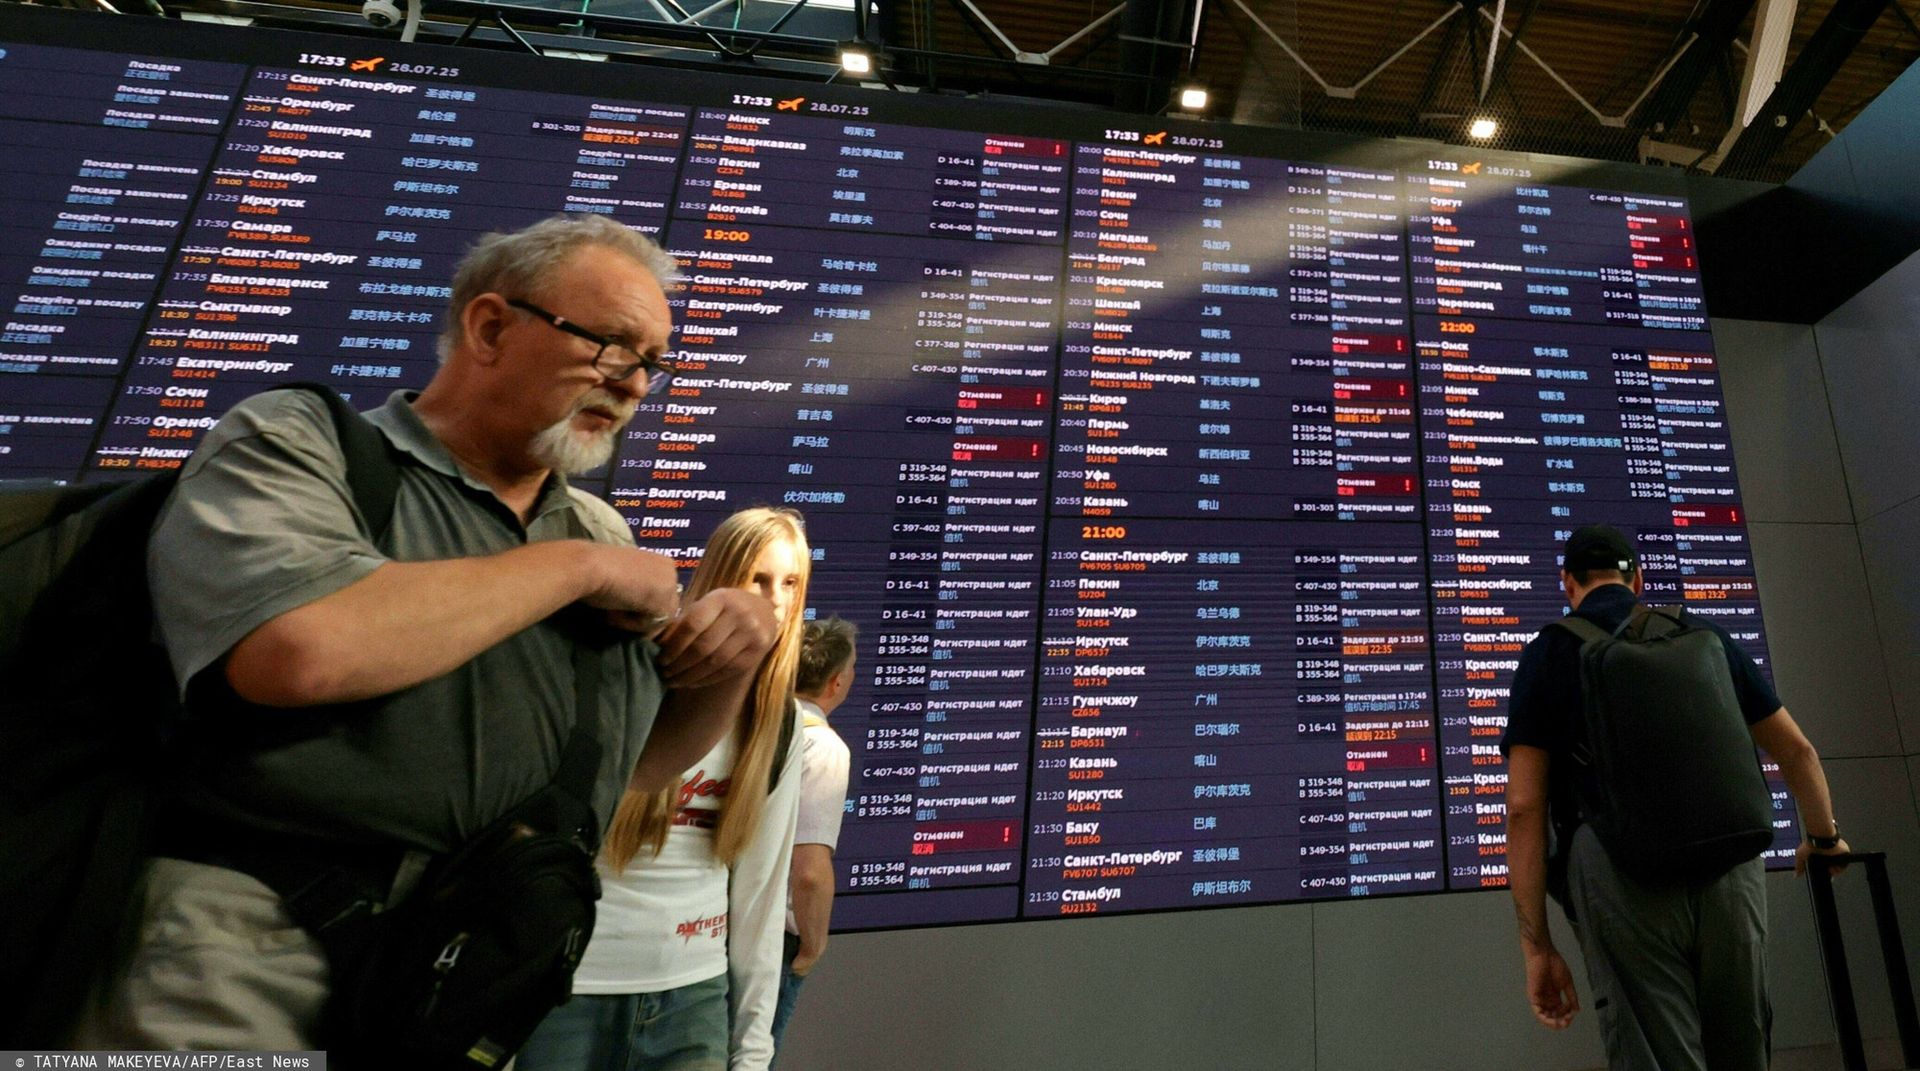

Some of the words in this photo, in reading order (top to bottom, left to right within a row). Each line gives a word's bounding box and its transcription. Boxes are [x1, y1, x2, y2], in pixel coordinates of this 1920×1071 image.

[128, 60, 181, 72] Посадка
[298, 54, 346, 66] 17:33
[390, 62, 460, 77] 28.07.25
[256, 71, 288, 81] 17:15
[290, 74, 416, 94] Санкт-Петербург
[118, 85, 166, 96] Посадка
[169, 89, 230, 100] закончена
[280, 97, 355, 112] Оренбург
[732, 95, 772, 106] 17:33
[810, 102, 869, 115] 28.07.25
[700, 112, 726, 120] 18:40
[728, 114, 770, 126] Минск
[237, 118, 269, 128] 17:20
[271, 120, 372, 138] Калининград
[652, 132, 679, 140] 22:45
[1104, 130, 1139, 142] 17:33
[1172, 136, 1224, 148] 28.07.25
[723, 136, 806, 150] Владикавказ
[985, 138, 1024, 148] Отменен
[226, 143, 259, 153] 17:20
[260, 144, 345, 160] Хабаровск
[1079, 146, 1102, 154] 20:00
[1104, 148, 1196, 164] Санкт-Петербург
[402, 157, 479, 172] 哈巴罗夫斯克
[690, 156, 716, 166] 18:50
[718, 158, 760, 170] Пекин
[836, 168, 859, 178] 北京
[1428, 161, 1458, 171] 17:33
[1486, 166, 1531, 178] 28.07.25
[252, 170, 318, 183] Стамбул
[394, 181, 460, 194] 伊斯坦布尔
[684, 178, 712, 187] 18:55
[714, 180, 762, 192] Ереван
[206, 193, 239, 202] 17:25
[242, 194, 306, 208] Иркутск
[1430, 198, 1462, 208] Сургут
[709, 202, 768, 216] Могилёв
[58, 212, 112, 223] Следуйте
[130, 218, 179, 228] посадку
[1100, 211, 1128, 221] Сочи
[232, 220, 292, 234] Самара
[704, 229, 750, 242] 19:00
[222, 246, 358, 264] Санкт-Петербург
[700, 250, 773, 264] Махачкала
[33, 266, 98, 278] Ожидание
[101, 270, 154, 280] посадки
[173, 272, 208, 282] 17:35
[210, 273, 329, 289] Благовещенск
[694, 274, 808, 291] Санкт-Петербург
[1096, 277, 1164, 289] Красноярск
[1436, 277, 1502, 290] Калининград
[688, 300, 782, 314] Екатеринбург
[6, 322, 65, 333] Посадка
[1440, 322, 1474, 333] 22:00
[188, 328, 299, 344] Калининград
[810, 332, 834, 342] 上海
[1441, 341, 1469, 351] Омск
[678, 350, 747, 364] Гуанчжоу
[806, 357, 830, 368] 广州
[138, 356, 174, 366] 17:45
[176, 357, 294, 373] Екатеринбург
[1442, 364, 1532, 376] Южно-Сахалинск
[172, 369, 216, 378] SU1414
[1064, 370, 1088, 378] 20:30
[1090, 370, 1138, 382] Нижний
[1140, 373, 1196, 385] Новгород
[126, 386, 162, 396] 17:50
[165, 386, 208, 398] Сочи
[1090, 394, 1128, 406] Киров
[666, 403, 716, 416] Пхукет
[1446, 408, 1504, 420] Чебоксары
[914, 416, 952, 424] 407-430
[956, 416, 1018, 427] Регистрация
[1022, 418, 1044, 427] идет
[1088, 420, 1129, 430] Пермь
[628, 430, 658, 440] 19:20
[660, 430, 716, 444] Самара
[1086, 445, 1168, 457] Новосибирск
[622, 458, 652, 468] 19:20
[654, 459, 706, 470] Казань
[1084, 470, 1110, 482] Уфа
[648, 488, 726, 500] Волгоград
[896, 496, 905, 504] D
[908, 496, 938, 504] 16-41
[1429, 504, 1452, 512] 22:15
[1454, 504, 1492, 514] Казань
[1672, 510, 1706, 518] Отменен
[642, 516, 690, 528] Пекин
[640, 529, 673, 538] CA910
[1082, 527, 1126, 539] 21:00
[1430, 529, 1454, 537] 22:20
[1456, 528, 1500, 539] Бангкок
[1052, 552, 1078, 560] 21:00
[1080, 552, 1188, 563] Санкт-Петербург
[1458, 554, 1530, 564] Новокузнецк
[1079, 580, 1120, 589] Пекин
[1683, 582, 1720, 590] Задержан
[1078, 591, 1106, 599] SU204
[1048, 608, 1074, 616] 21:05
[1077, 608, 1137, 618] Улан-Удэ
[889, 635, 929, 644] 319-348
[934, 639, 999, 649] Регистрация
[1002, 639, 1028, 647] идет
[1442, 689, 1464, 698] 22:35
[1468, 688, 1510, 698] Урумчи
[1042, 696, 1070, 706] 21:15
[1072, 696, 1138, 708] Гуанчжоу
[1036, 791, 1064, 800] 21:20
[1068, 788, 1123, 802] Иркутск
[1066, 802, 1102, 812] SU1442
[1449, 806, 1473, 814] 22:45
[1034, 824, 1062, 834] 21:30
[1066, 822, 1099, 835] Баку
[1194, 817, 1216, 829] 巴库
[914, 830, 964, 842] Отменен
[910, 863, 982, 876] Регистрация
[984, 862, 1012, 872] идет
[1063, 868, 1098, 878] FV6707
[1100, 866, 1136, 876] SU6707
[1453, 866, 1478, 876] 22:50
[850, 878, 858, 886] B
[860, 876, 904, 886] 355-364
[1301, 879, 1308, 888] C
[1310, 877, 1346, 887] 407-430
[1029, 892, 1059, 902] 21:30
[1062, 887, 1121, 902] Стамбул
[1060, 902, 1097, 914] SU2132
